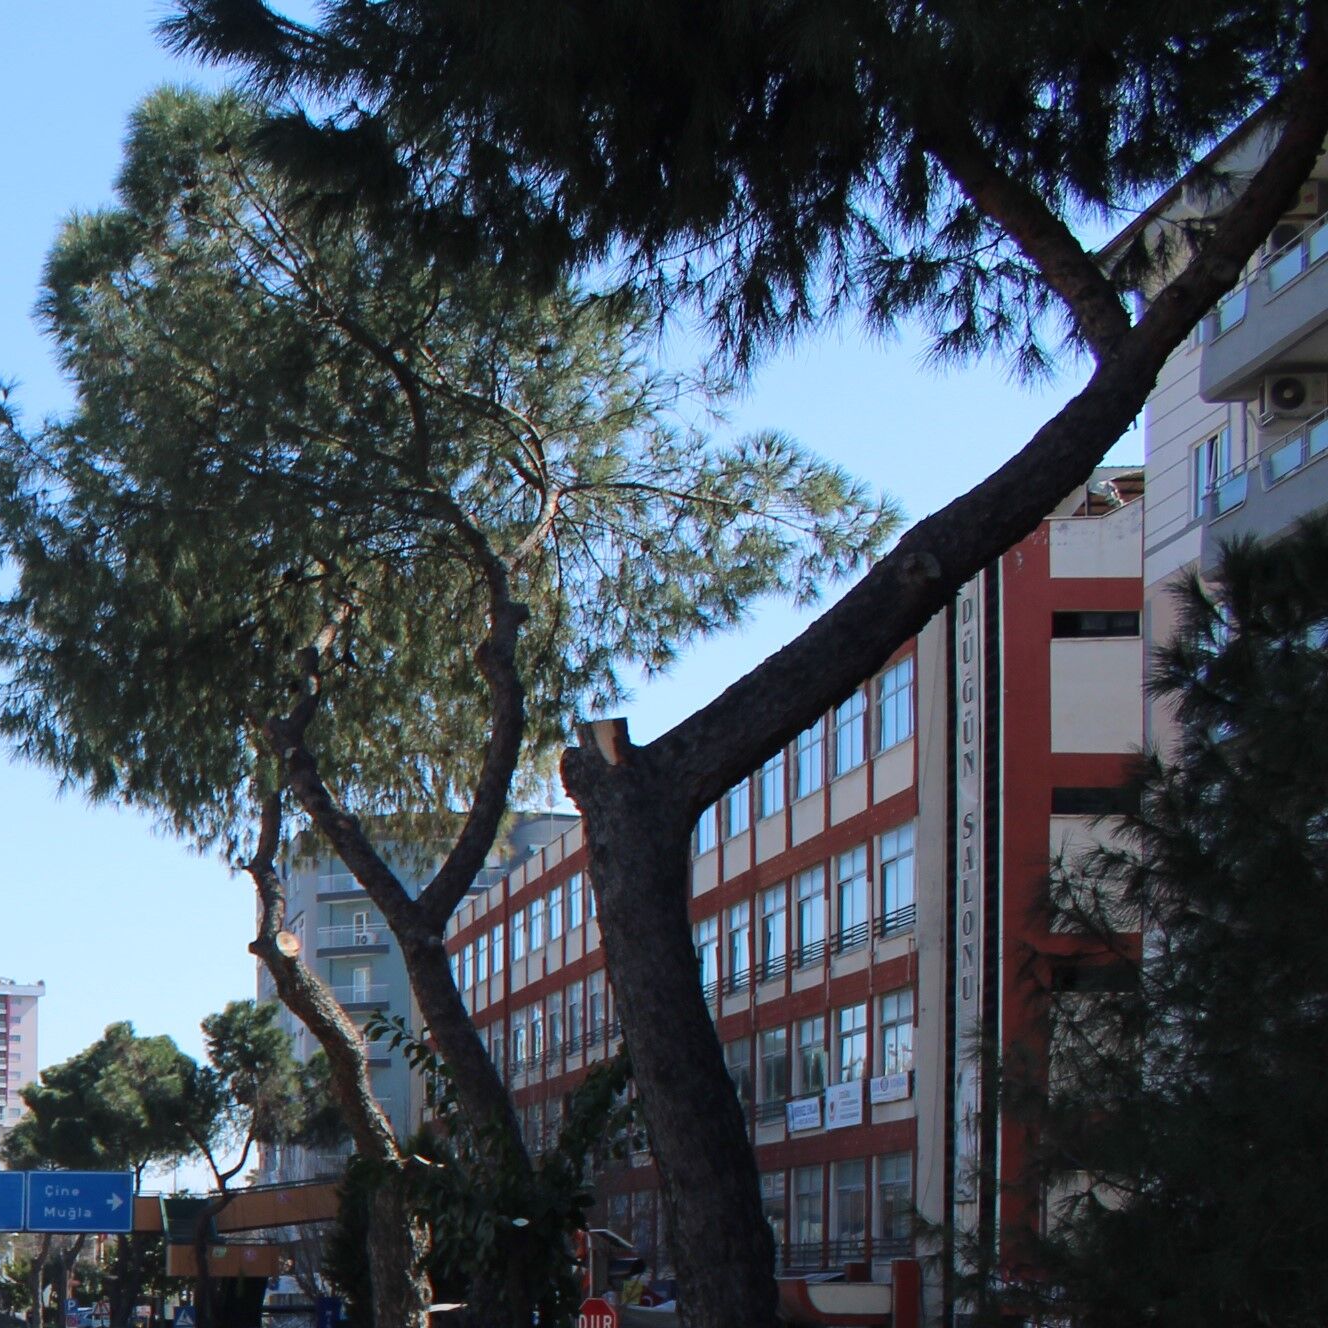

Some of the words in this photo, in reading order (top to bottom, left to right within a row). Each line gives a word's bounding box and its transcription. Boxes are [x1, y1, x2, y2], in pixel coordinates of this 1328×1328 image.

[962, 598, 975, 778] DÜĞÜN
[962, 812, 976, 1001] SALONU
[44, 1185, 80, 1198] Çine
[44, 1206, 93, 1219] Muğla
